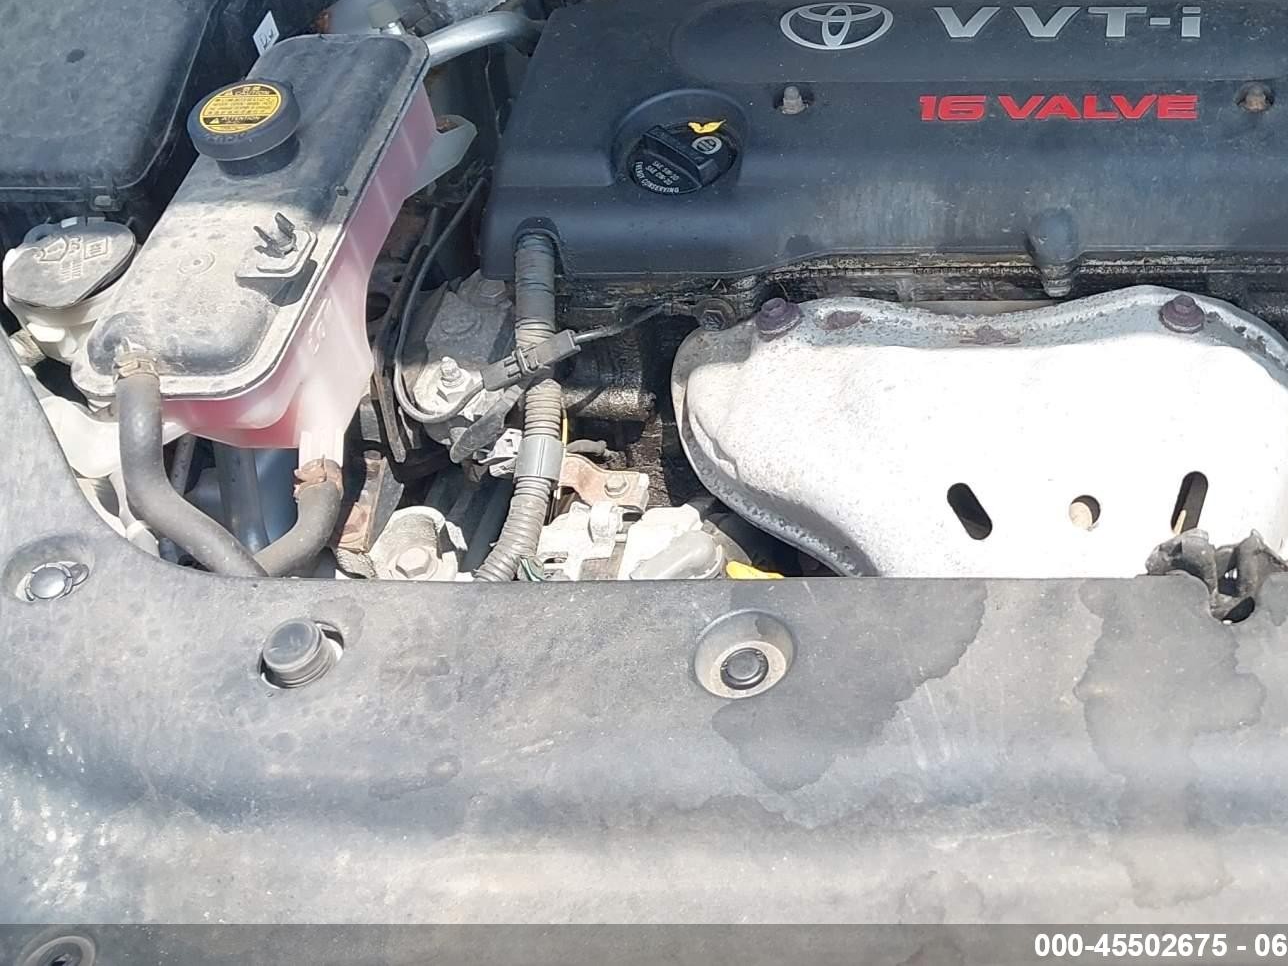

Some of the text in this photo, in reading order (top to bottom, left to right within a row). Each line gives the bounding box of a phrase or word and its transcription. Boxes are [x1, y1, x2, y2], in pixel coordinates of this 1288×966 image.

[919, 94, 1199, 120] 16 VALVE
[641, 178, 680, 194] CONSERVING
